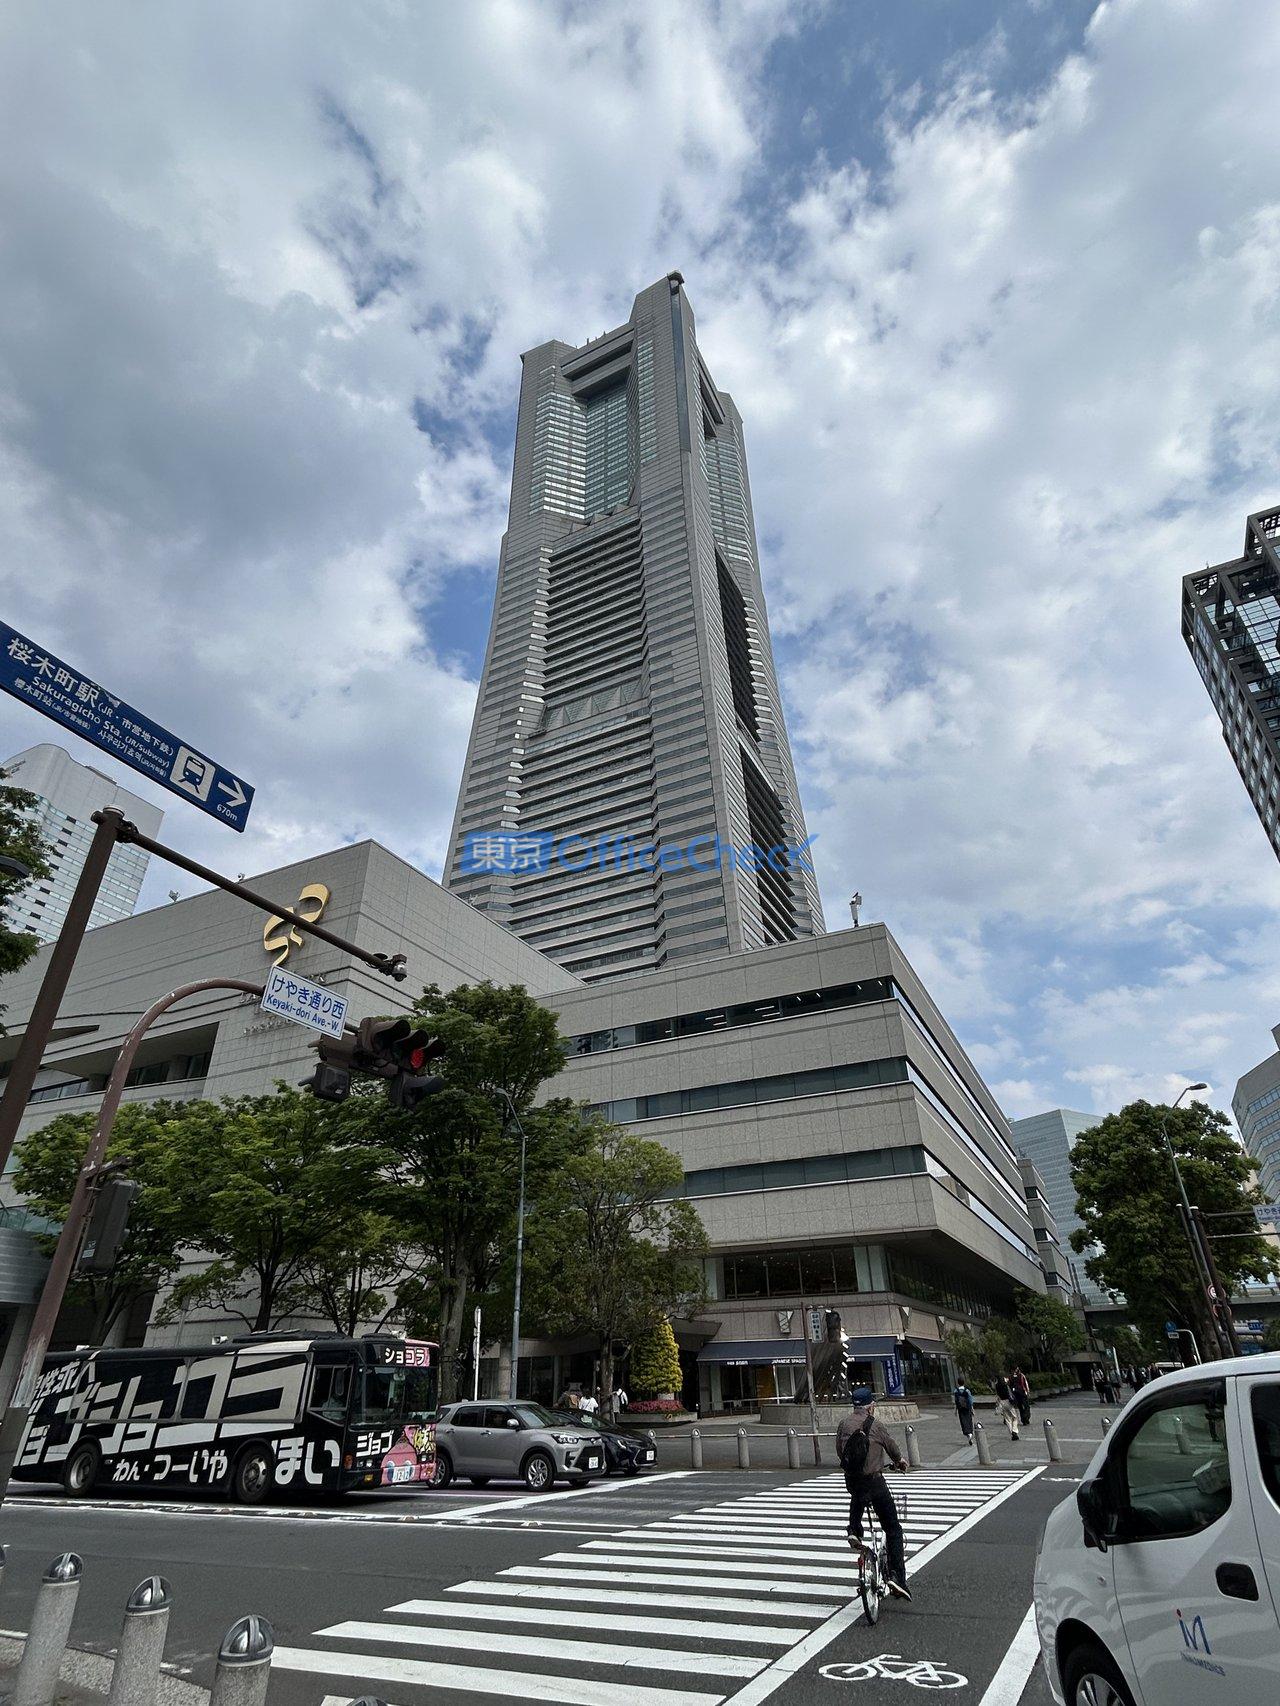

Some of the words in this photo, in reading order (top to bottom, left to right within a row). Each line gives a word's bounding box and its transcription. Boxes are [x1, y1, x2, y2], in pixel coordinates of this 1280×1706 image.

[7, 637, 99, 708] 桜木町駅
[32, 676, 101, 724] Sakuragicho
[103, 720, 122, 738] Sta.
[125, 736, 170, 768] (JR/Subway)
[216, 803, 238, 821] 670m
[266, 994, 311, 1020] Keyaki-dori
[272, 975, 345, 1020] けやき通り西
[385, 1347, 425, 1364] ショコラ
[271, 1436, 341, 1485] ほい
[356, 1429, 395, 1458] ジョブ
